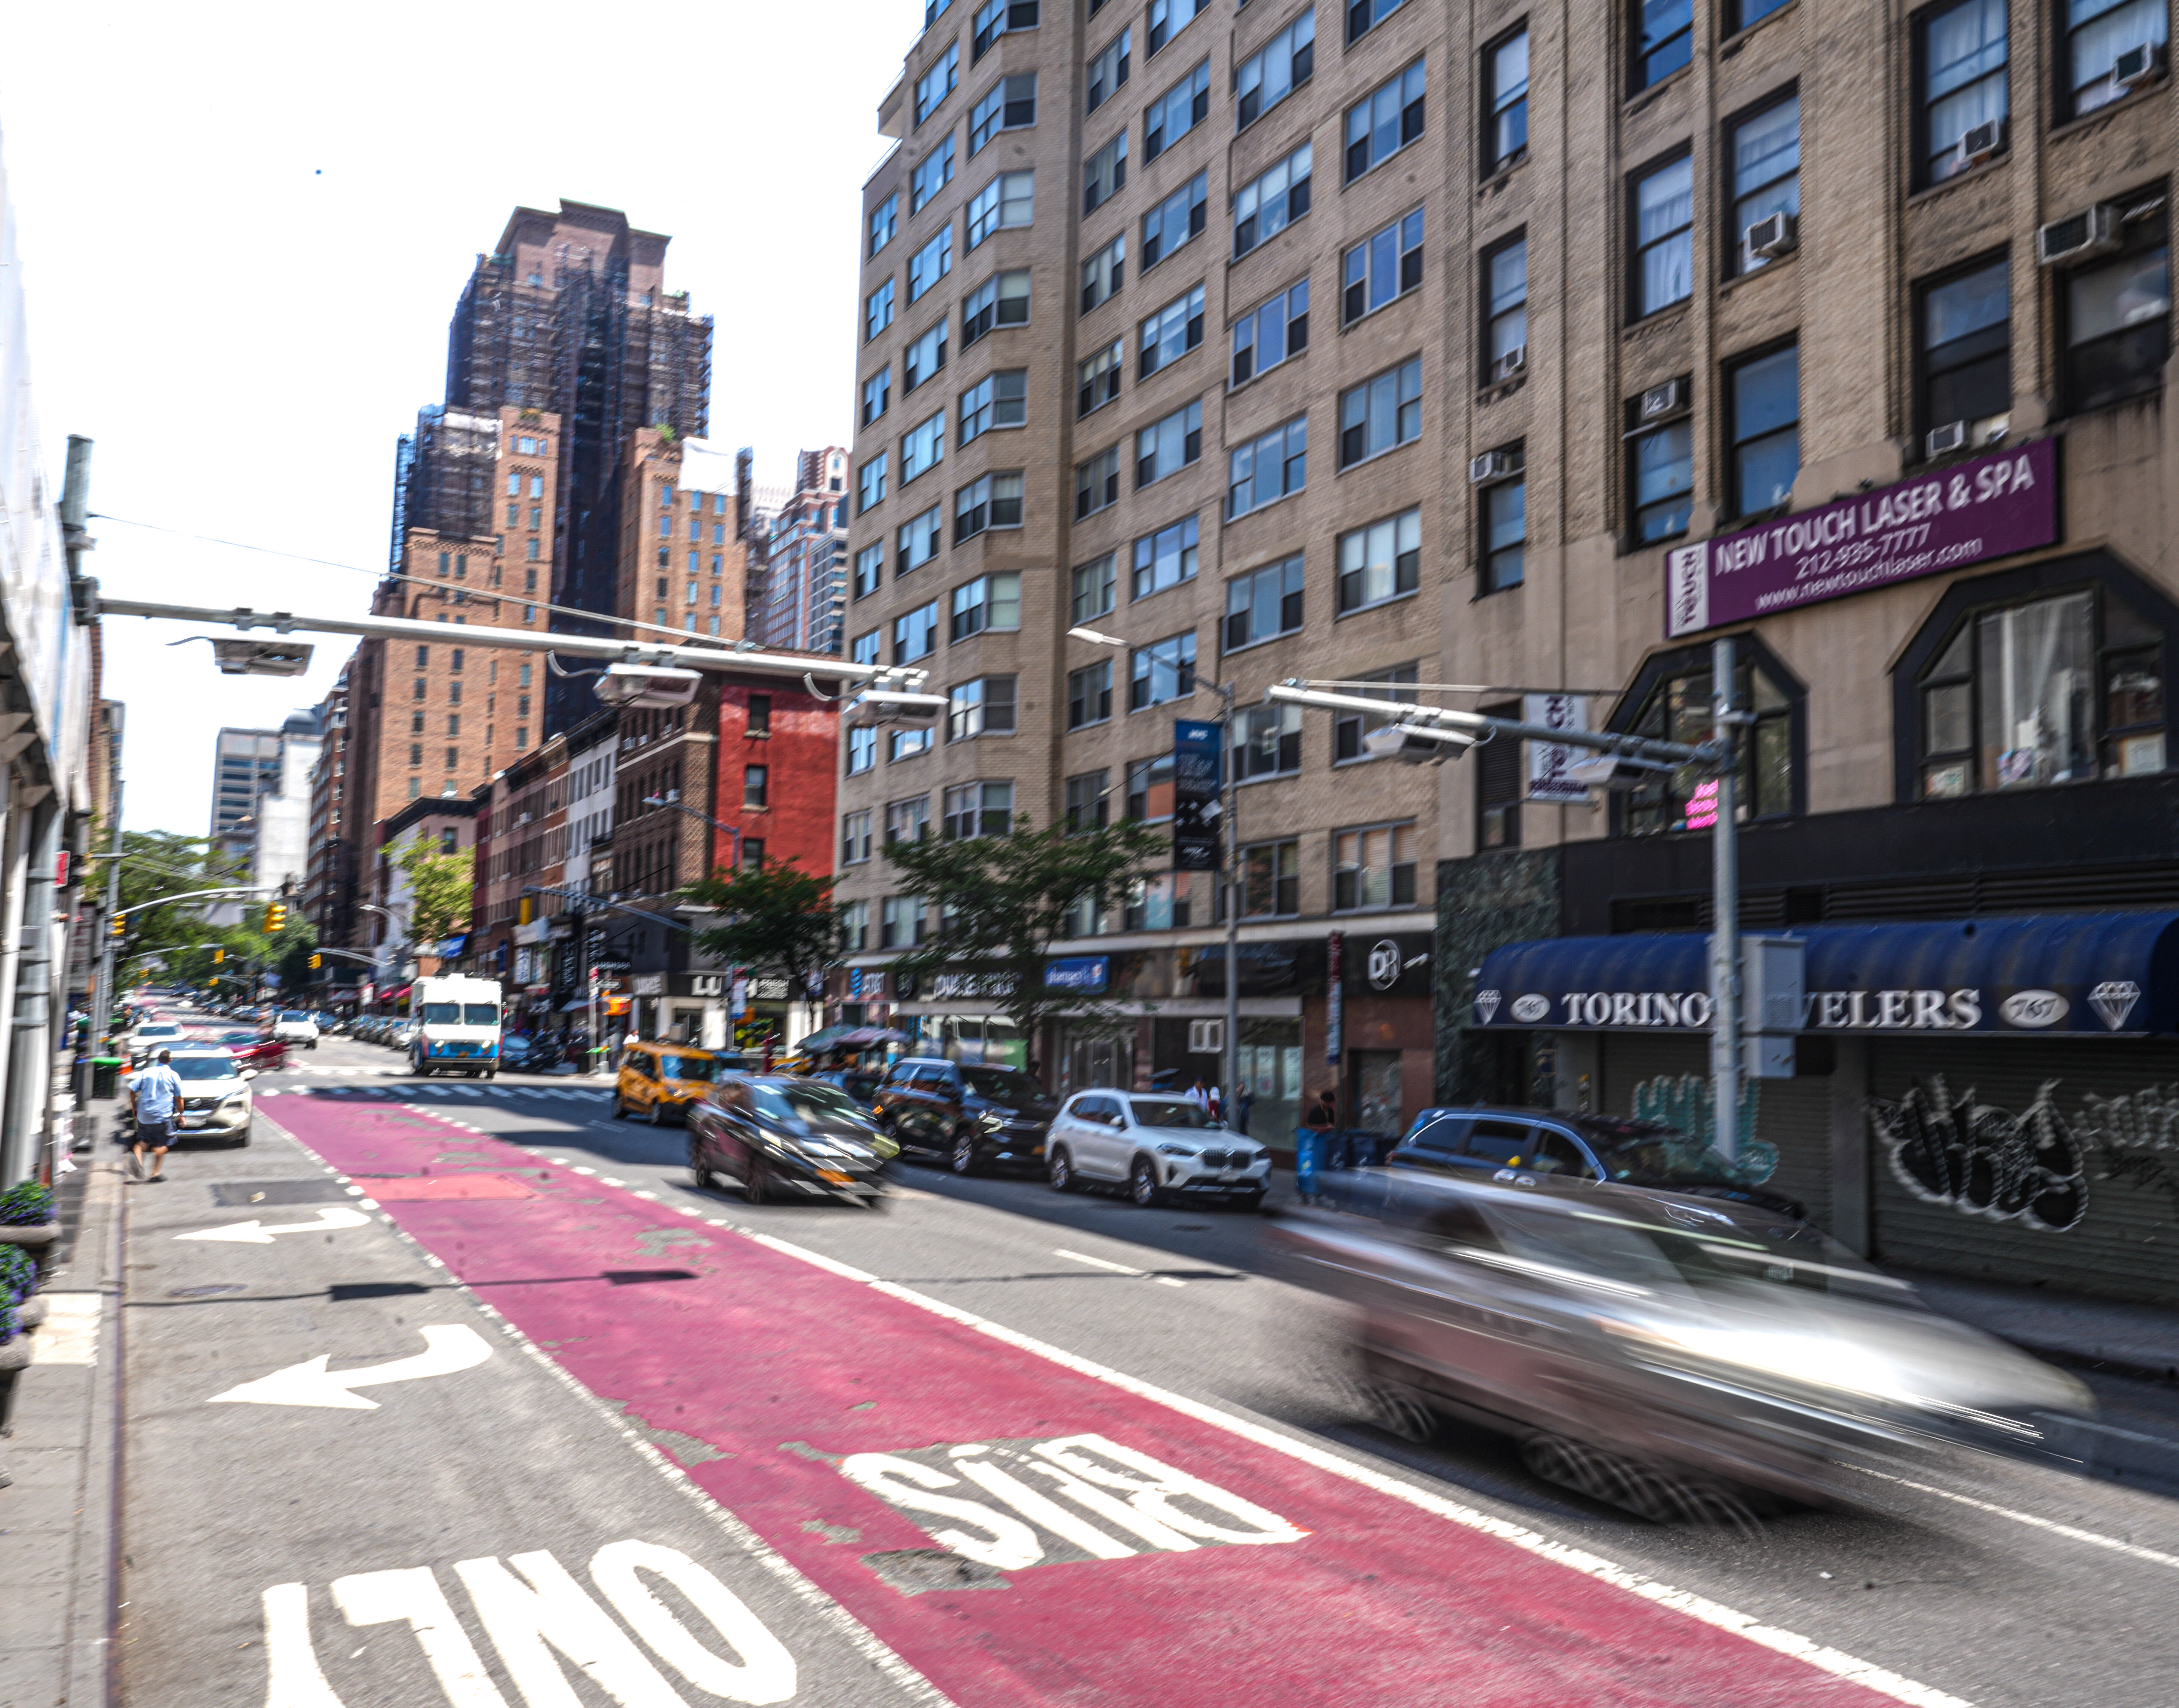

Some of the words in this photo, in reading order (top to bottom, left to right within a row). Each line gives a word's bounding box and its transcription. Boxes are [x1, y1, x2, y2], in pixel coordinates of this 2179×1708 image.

[1715, 531, 1769, 577] NEW
[1770, 506, 1856, 560] TOUCH
[1859, 480, 1944, 536] LASER
[1947, 472, 1972, 511] &
[1975, 454, 2035, 503] SPA
[1561, 992, 1713, 1027] TORINO
[840, 1433, 1313, 1571] BUS
